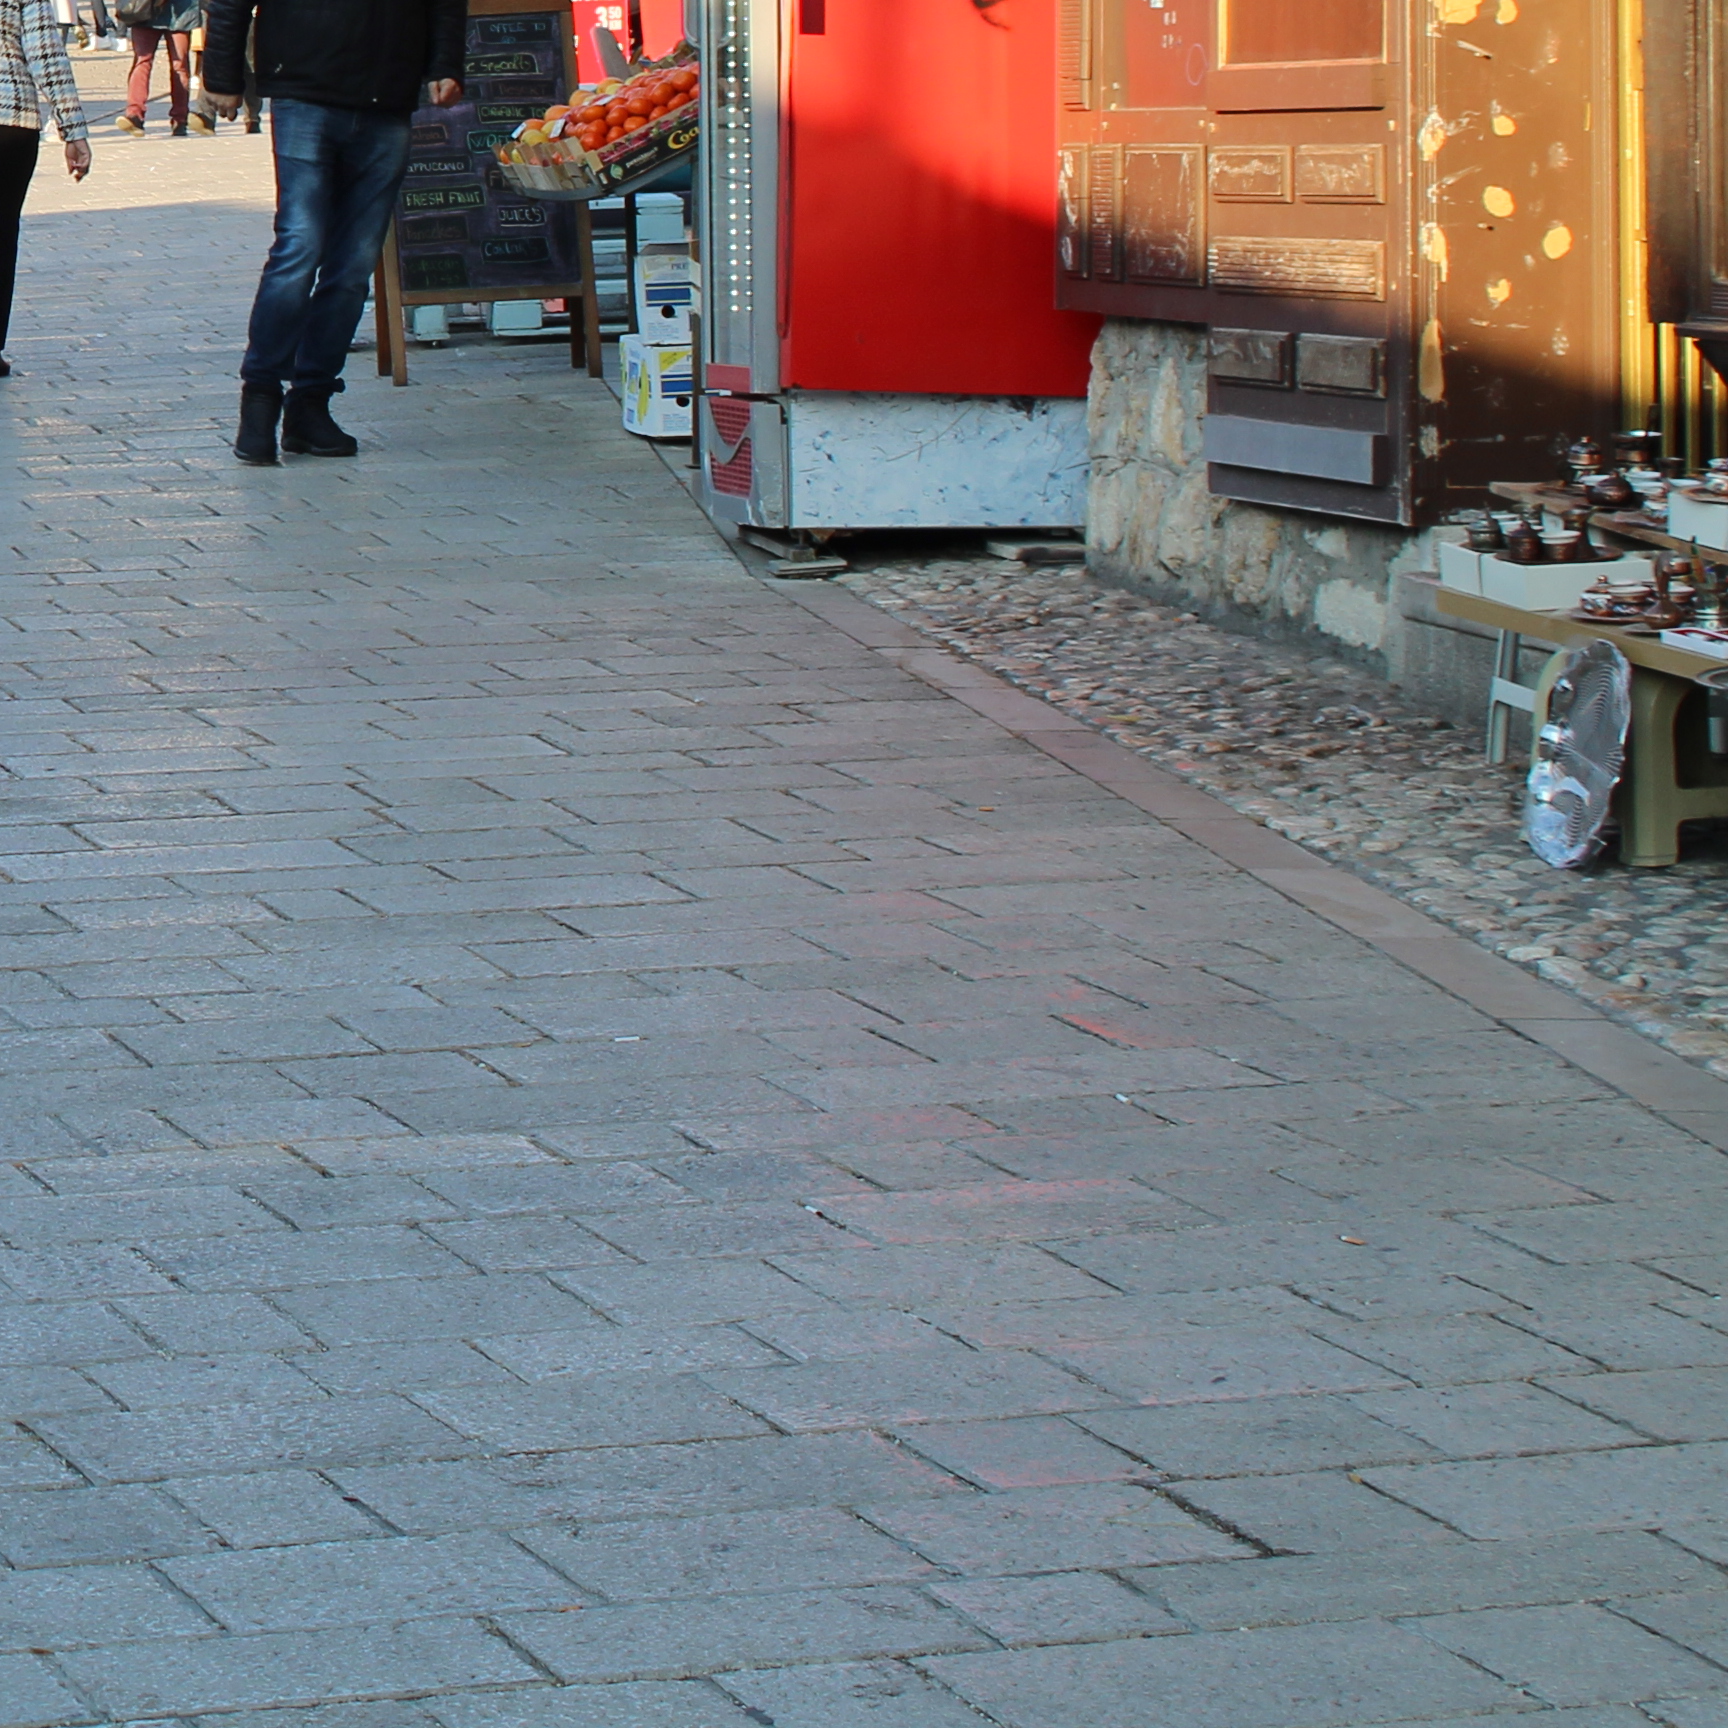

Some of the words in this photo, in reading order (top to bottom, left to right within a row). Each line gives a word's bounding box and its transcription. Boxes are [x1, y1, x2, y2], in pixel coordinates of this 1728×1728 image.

[595, 6, 608, 28] 3
[608, 6, 622, 19] 50
[406, 192, 444, 206] FRESH
